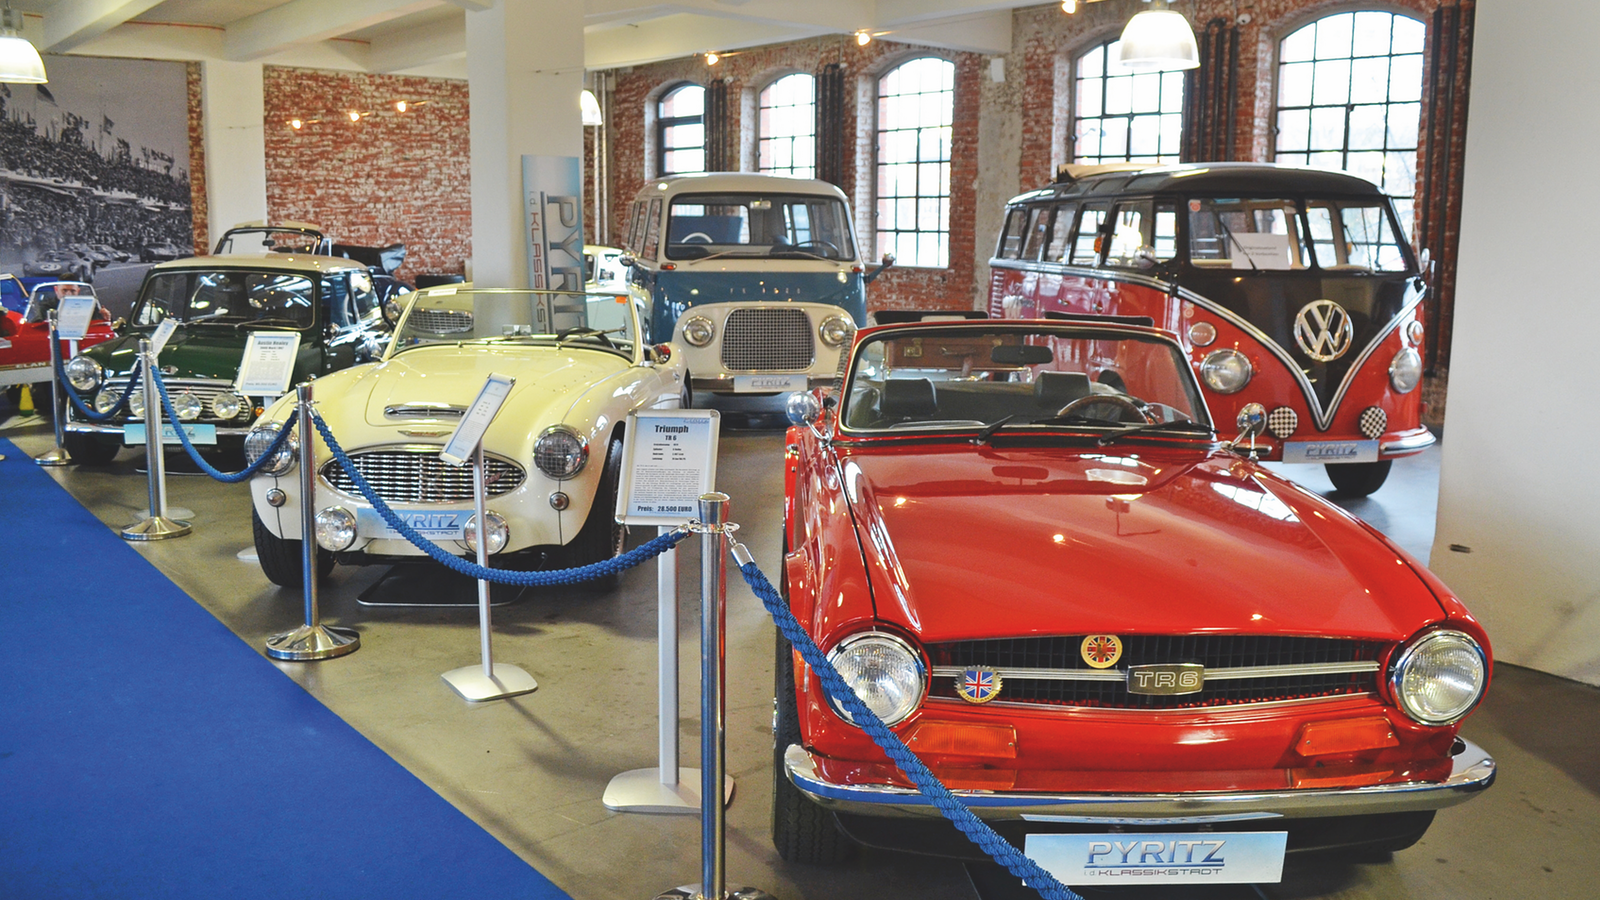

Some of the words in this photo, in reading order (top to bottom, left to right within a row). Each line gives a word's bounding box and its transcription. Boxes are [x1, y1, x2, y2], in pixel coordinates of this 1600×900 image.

[1295, 299, 1353, 361] VW
[15, 361, 46, 369] ELAN
[751, 376, 791, 387] PYRITZ
[655, 424, 689, 433] Triumph
[1305, 442, 1358, 456] PYRITZ
[388, 513, 460, 528] YRITZ
[1134, 671, 1199, 688] TR6
[962, 691, 995, 703] ENGLAND
[1087, 839, 1226, 864] PYRITZ
[1098, 868, 1223, 876] KLASSIKSTADT
